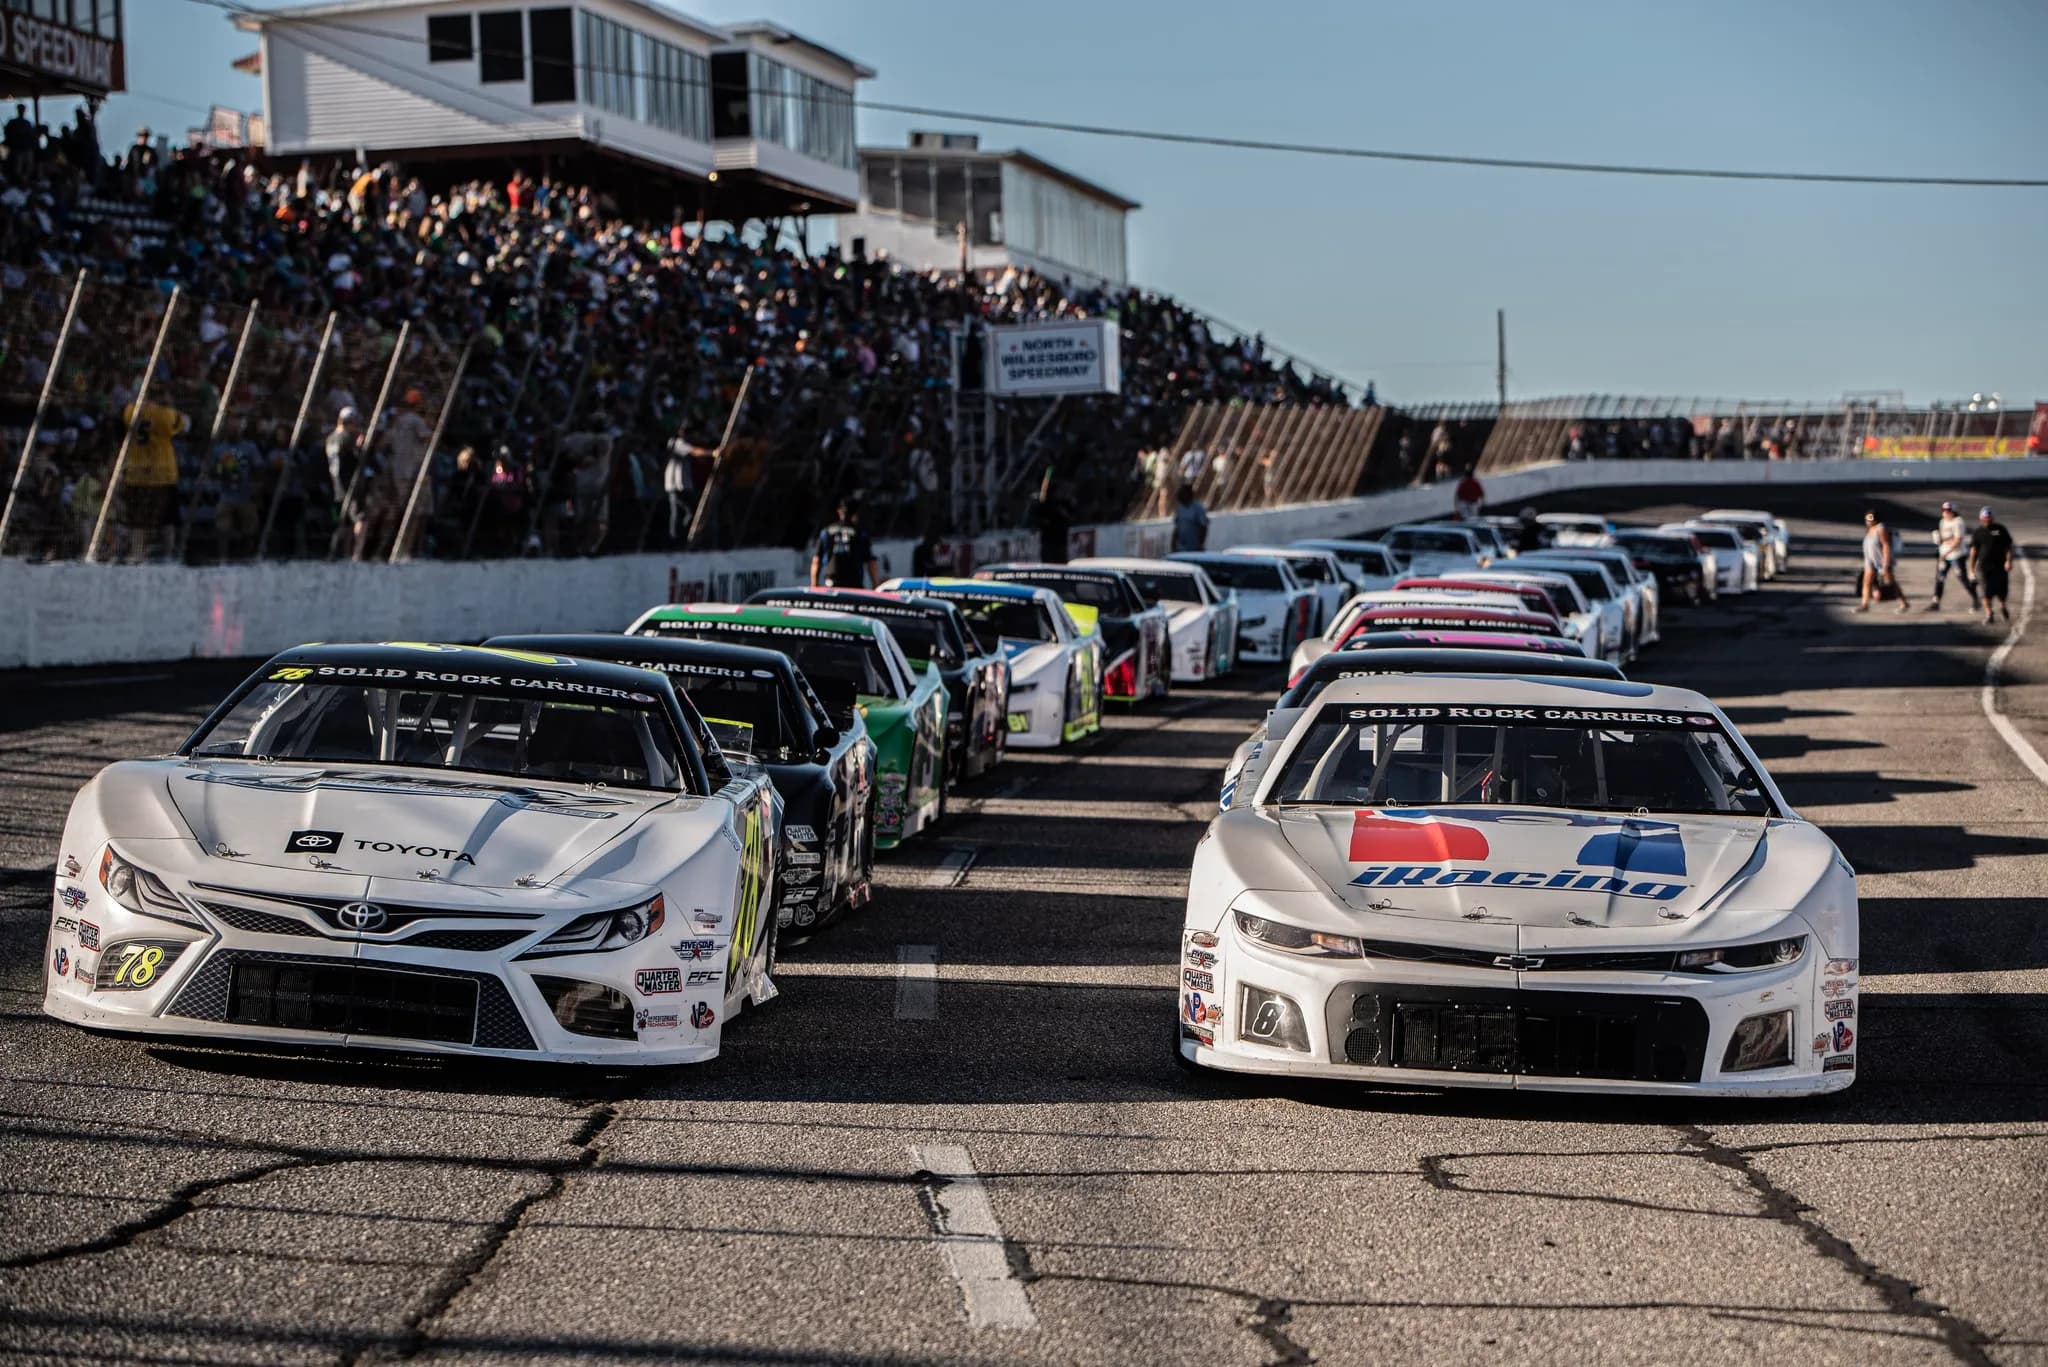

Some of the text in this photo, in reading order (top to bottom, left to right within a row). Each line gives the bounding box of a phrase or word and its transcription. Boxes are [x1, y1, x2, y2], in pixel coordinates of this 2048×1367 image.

[12, 14, 114, 87] SPEEDWAY
[1022, 338, 1076, 350] NORTH
[1001, 350, 1098, 366] WILKESBORO
[1008, 365, 1091, 380] SPEEDWAY
[659, 621, 855, 642] SOLID ROCK CARRIERS
[268, 667, 314, 681] 78
[639, 661, 747, 679] CARRIERS
[318, 666, 632, 700] SOLID ROCK CARRIER
[1349, 707, 1685, 726] SOLID ROCK CARRIERS
[353, 839, 478, 866] TOYOTA
[1348, 866, 1688, 901] iRacing
[55, 916, 79, 931] PFC
[114, 943, 164, 988] 78
[637, 970, 679, 985] QUARTER
[688, 970, 724, 982] PFC
[1184, 970, 1213, 982] QUARTER
[644, 980, 680, 993] MASTER
[1252, 1000, 1286, 1037] 8
